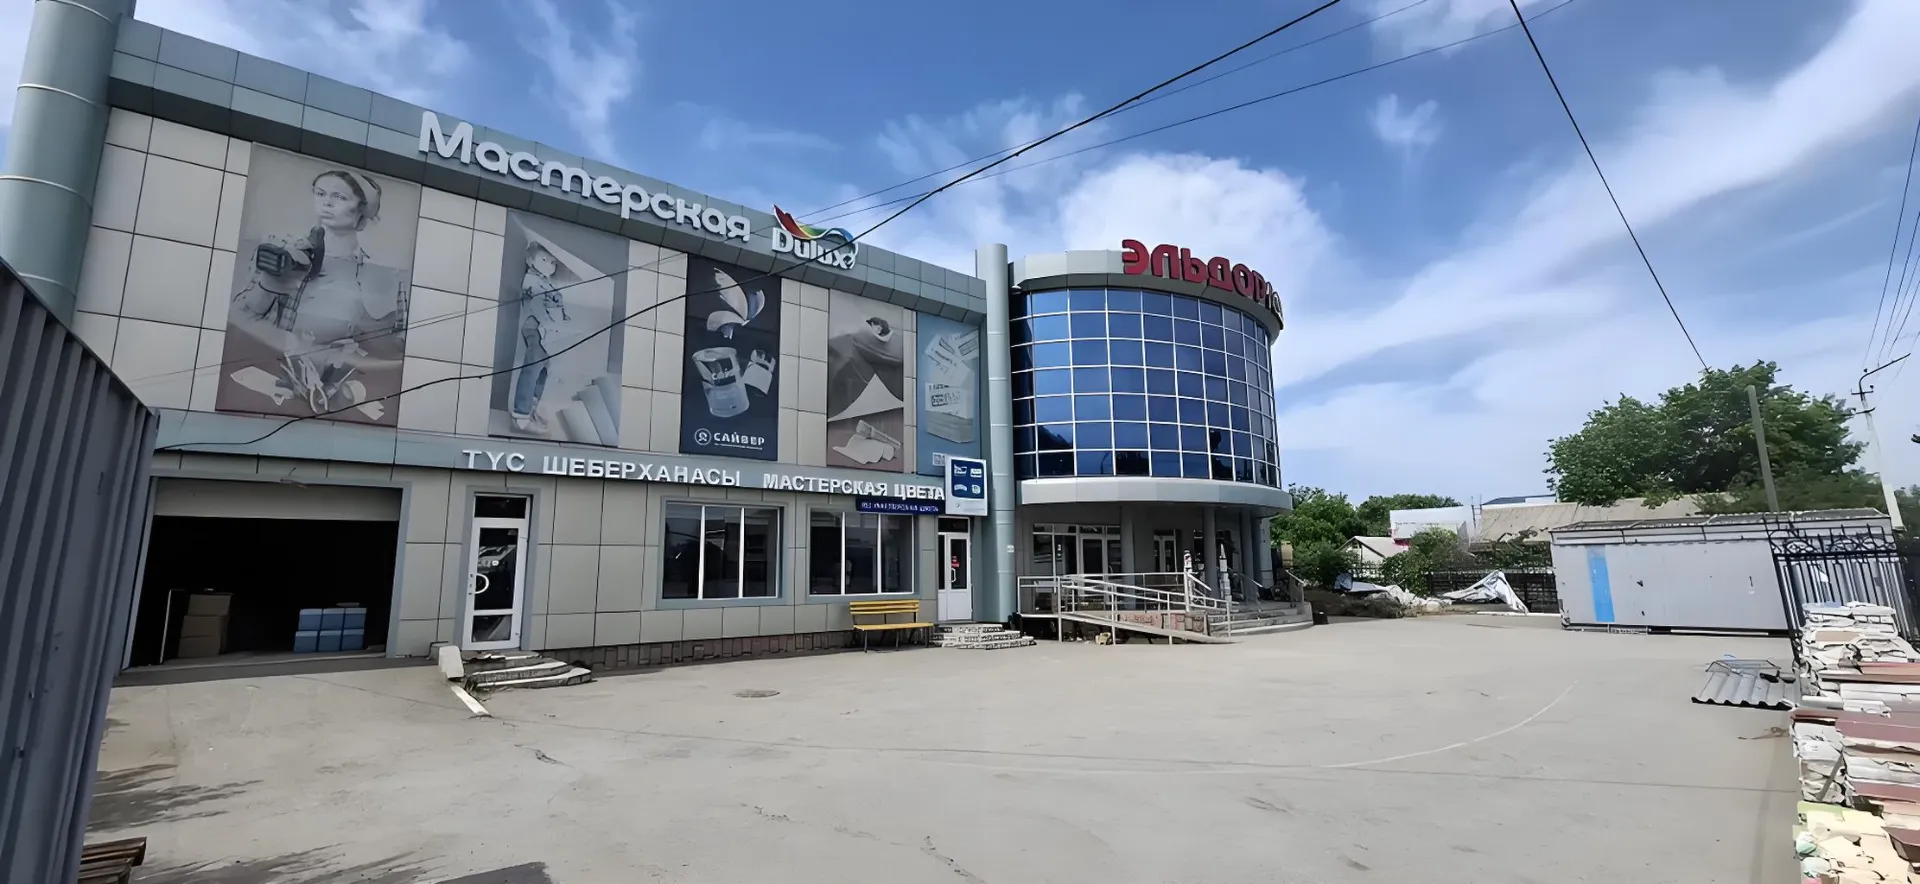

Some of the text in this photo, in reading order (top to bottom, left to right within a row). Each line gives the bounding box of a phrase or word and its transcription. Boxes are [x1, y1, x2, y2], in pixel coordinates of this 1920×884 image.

[418, 111, 750, 242] Мастерская
[771, 227, 856, 270] Dulux
[713, 432, 765, 446] САЙВЕР
[543, 456, 740, 487] ШЕБЕРХАНАСЫ
[763, 473, 888, 497] МАСТЕРСКАЯ
[893, 483, 945, 500] ЦВЕТА
